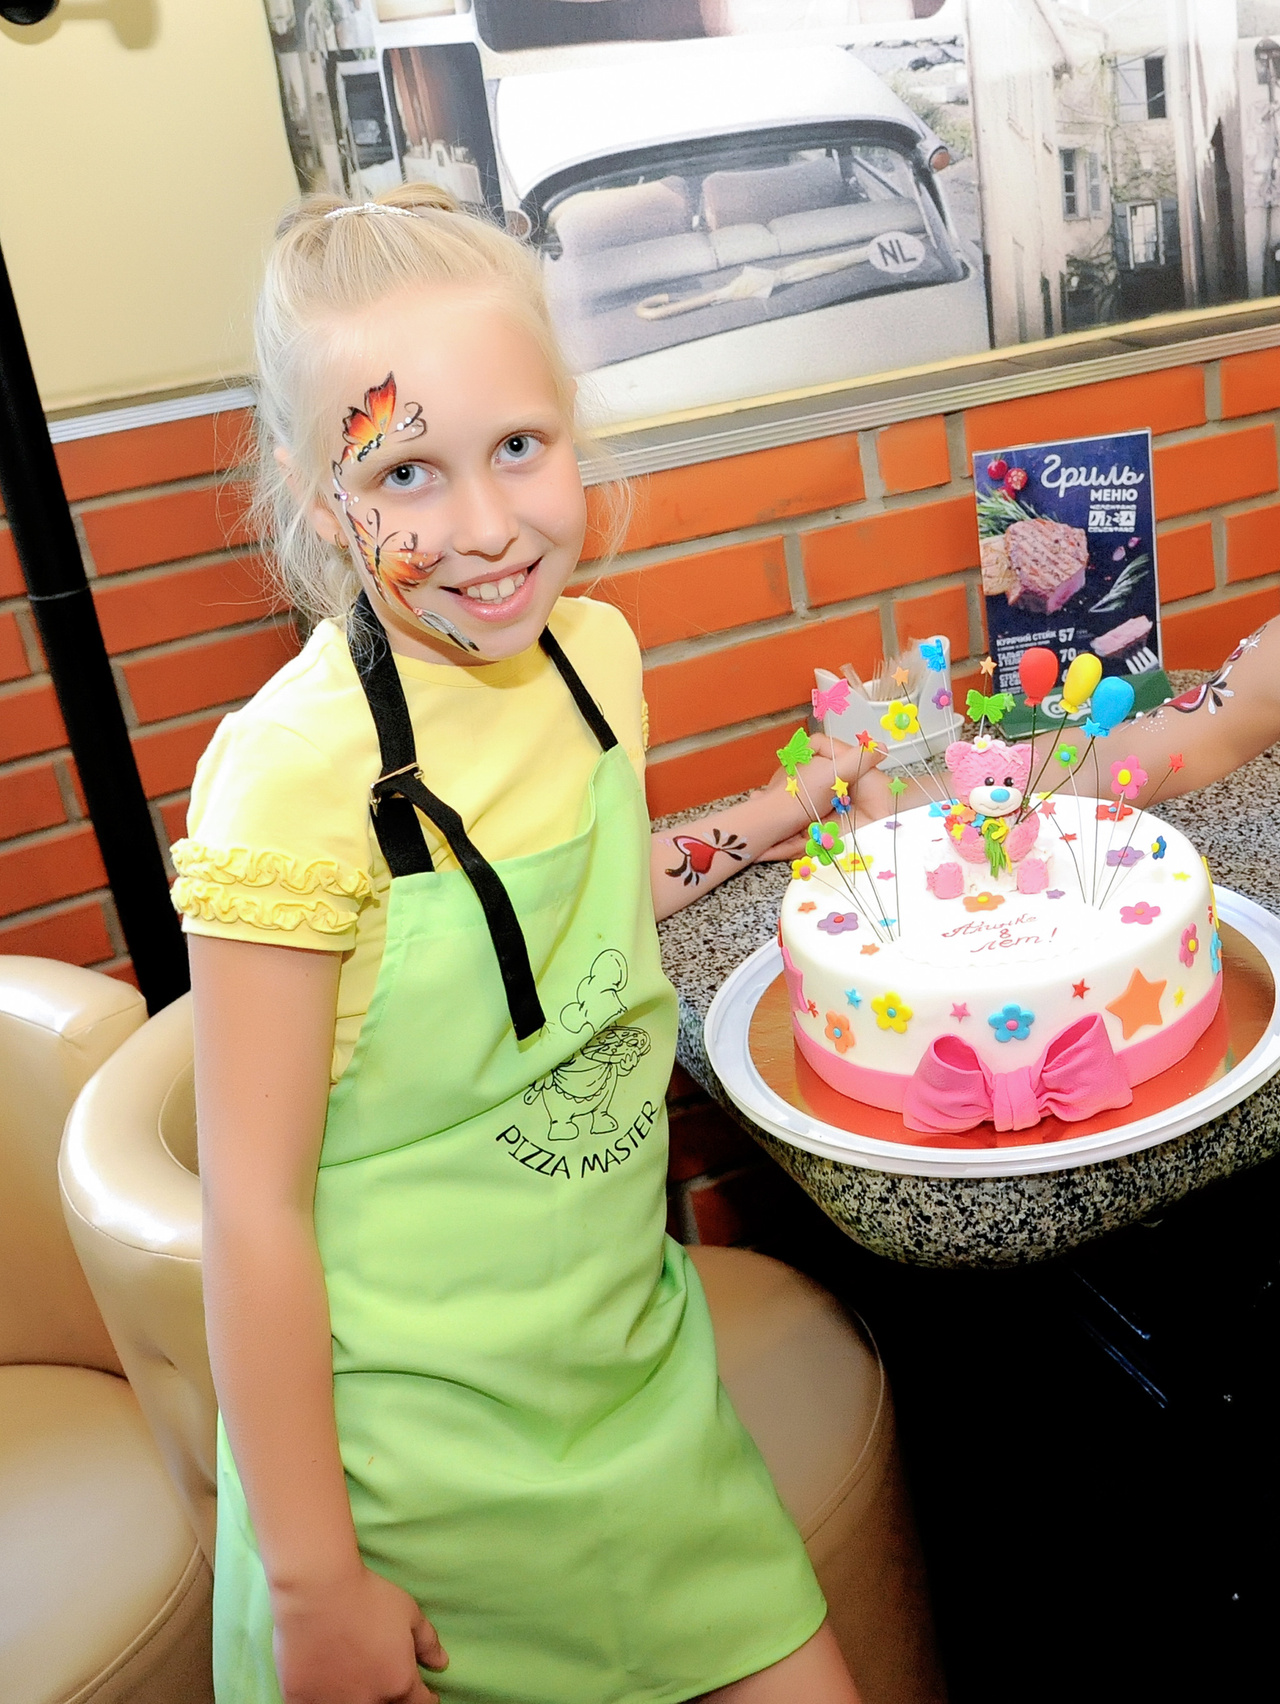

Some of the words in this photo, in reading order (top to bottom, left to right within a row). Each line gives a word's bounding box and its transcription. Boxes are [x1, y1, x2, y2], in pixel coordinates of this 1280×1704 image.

[877, 239, 917, 267] NL
[1040, 453, 1145, 498] Гриль
[1090, 488, 1139, 502] МЕНЮ
[1058, 628, 1075, 642] 57
[1060, 648, 1077, 662] 70
[999, 928, 1012, 939] 8
[495, 1124, 570, 1180] PIZZA
[581, 1100, 658, 1179] MASTER
